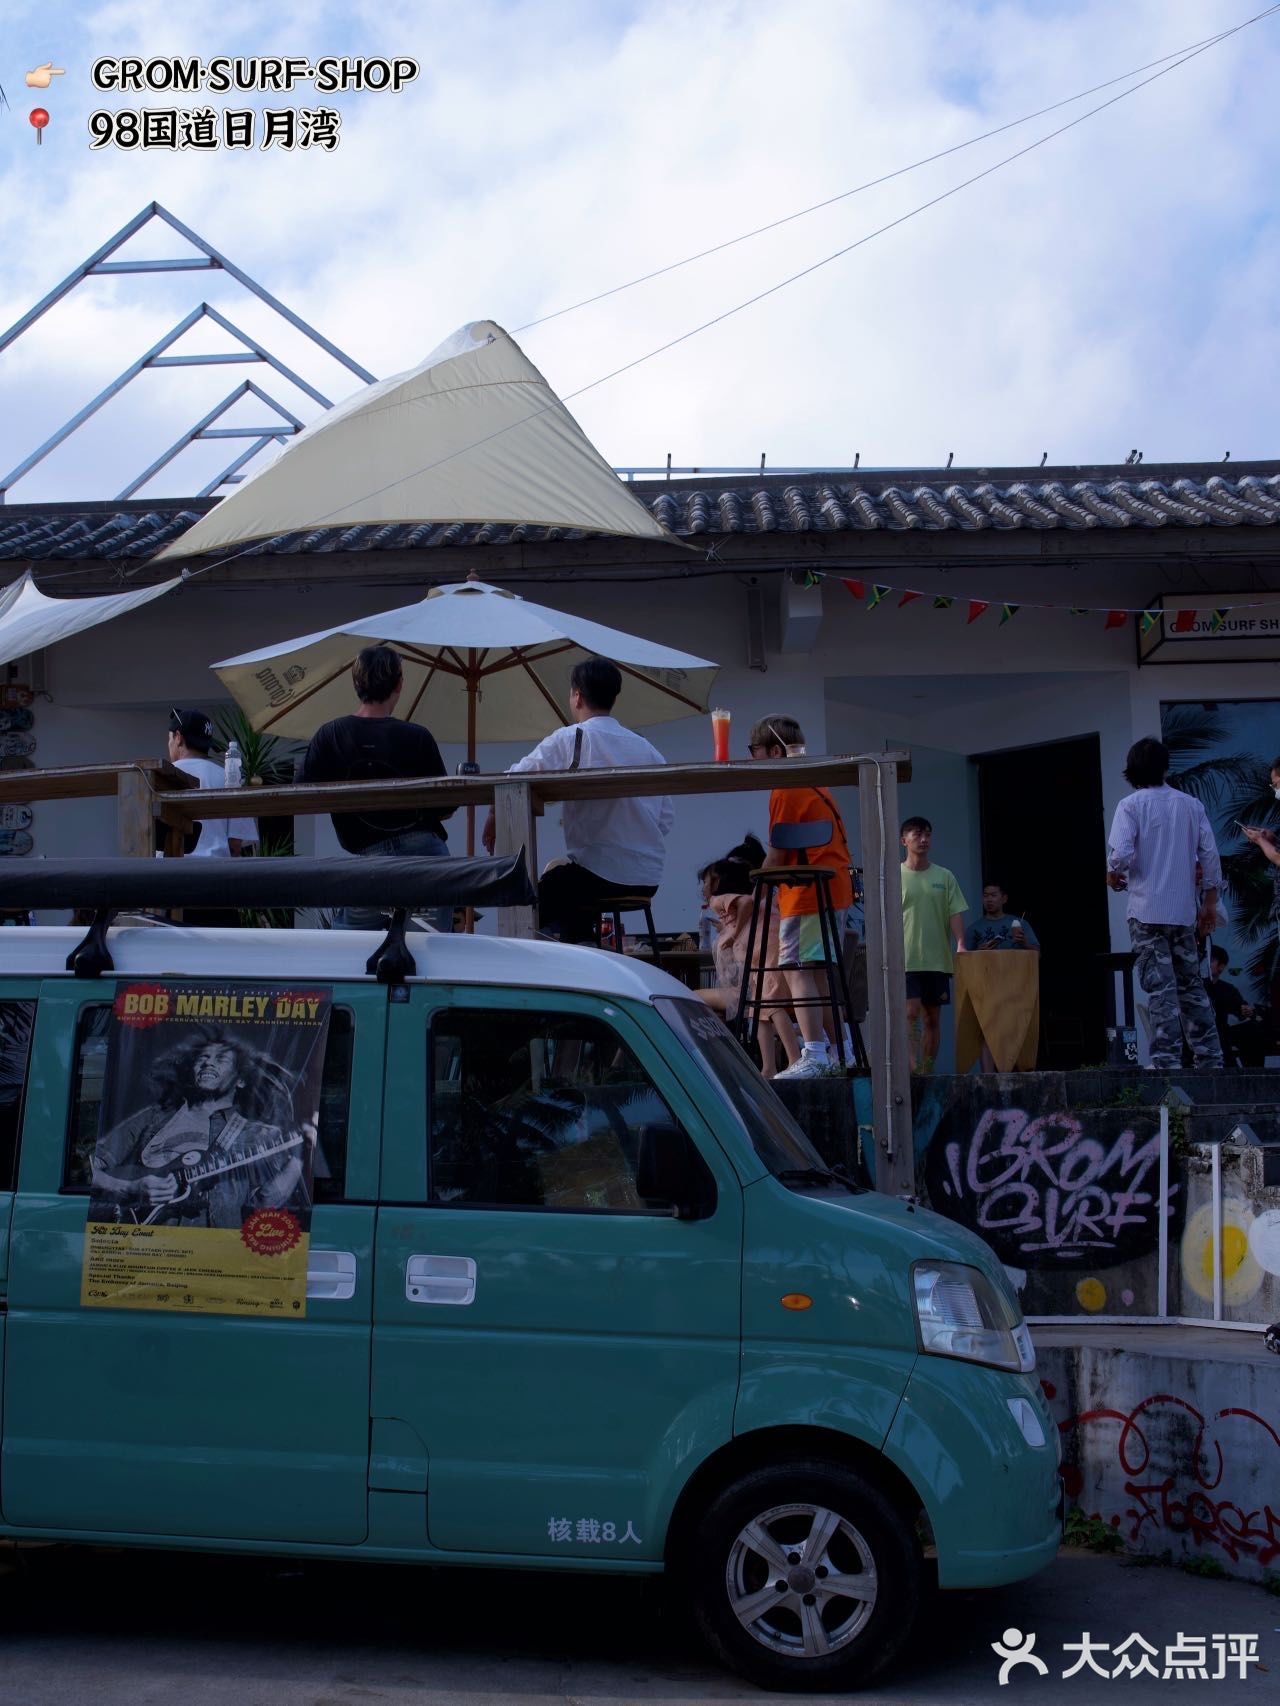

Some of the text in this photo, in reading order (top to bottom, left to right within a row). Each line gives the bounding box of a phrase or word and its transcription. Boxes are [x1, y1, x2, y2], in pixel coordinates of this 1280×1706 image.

[1170, 621, 1213, 633] GOM
[1219, 620, 1256, 631] SURF
[124, 993, 320, 1019] BOB MARLEY DAY
[547, 1517, 643, 1545] 核载8人
